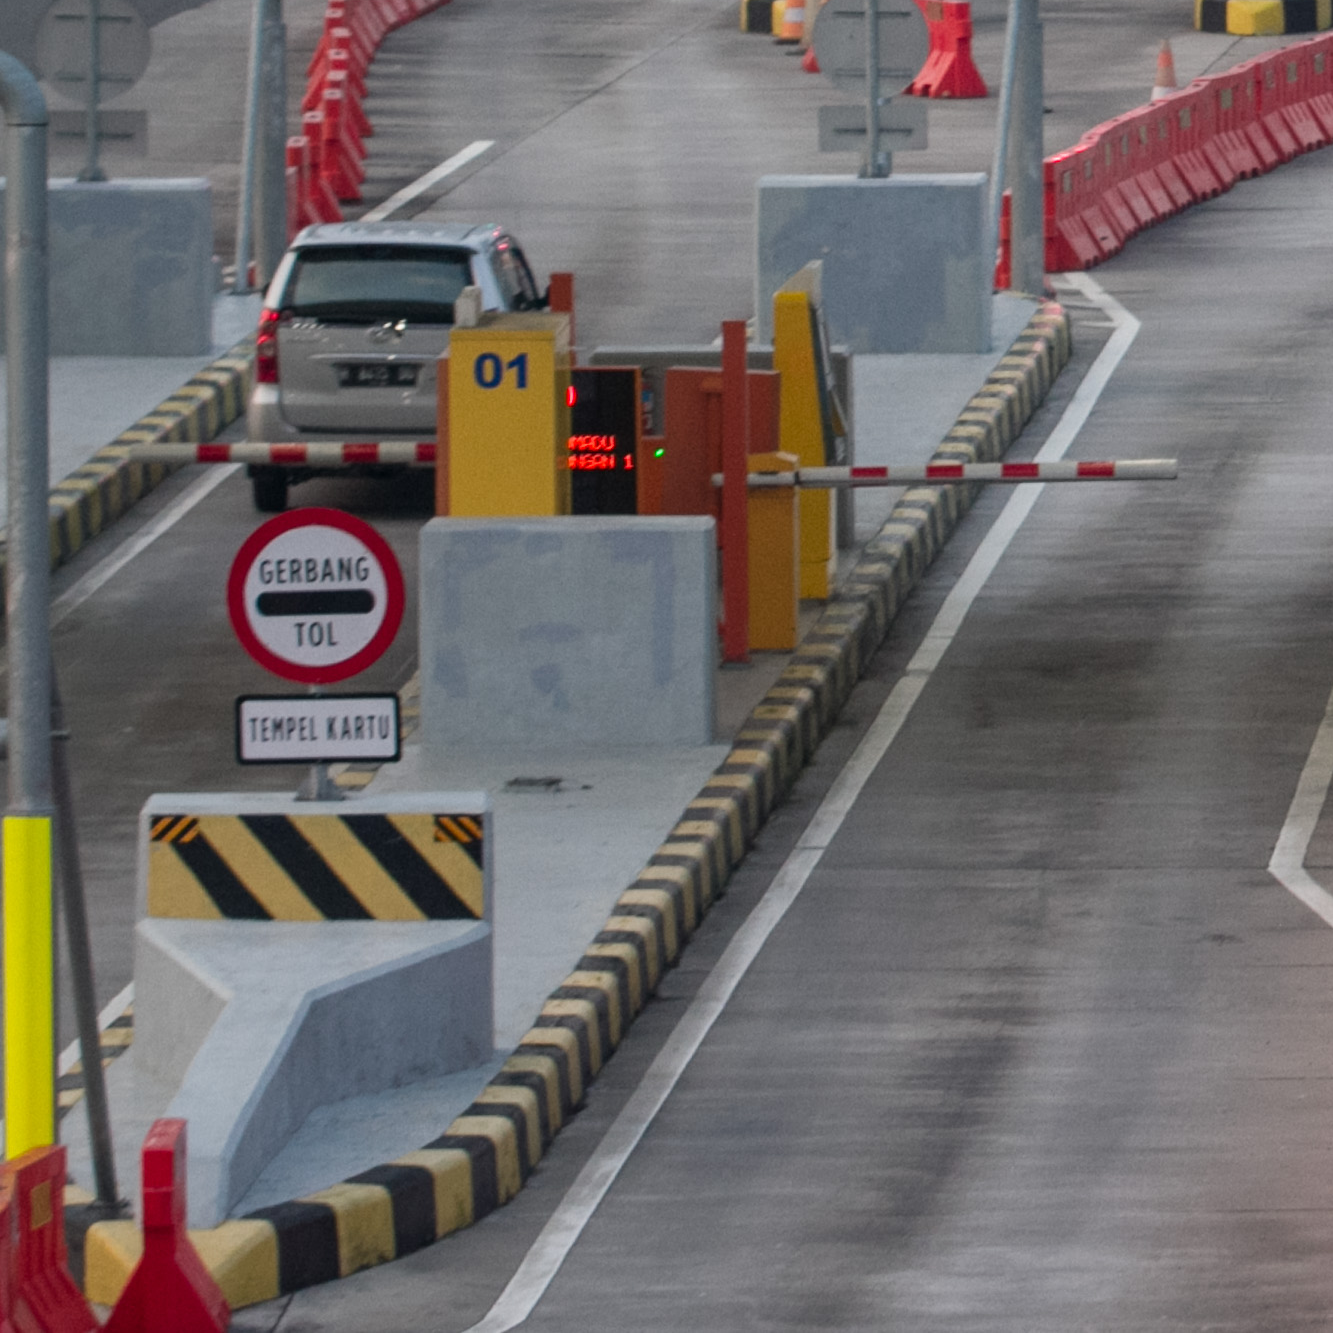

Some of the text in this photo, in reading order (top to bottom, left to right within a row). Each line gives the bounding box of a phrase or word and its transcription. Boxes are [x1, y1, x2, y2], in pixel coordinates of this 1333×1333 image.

[474, 351, 530, 389] 01
[258, 555, 370, 584] GERBANG
[293, 622, 339, 647] TOL
[249, 713, 390, 742] TEMPEL KARTU
